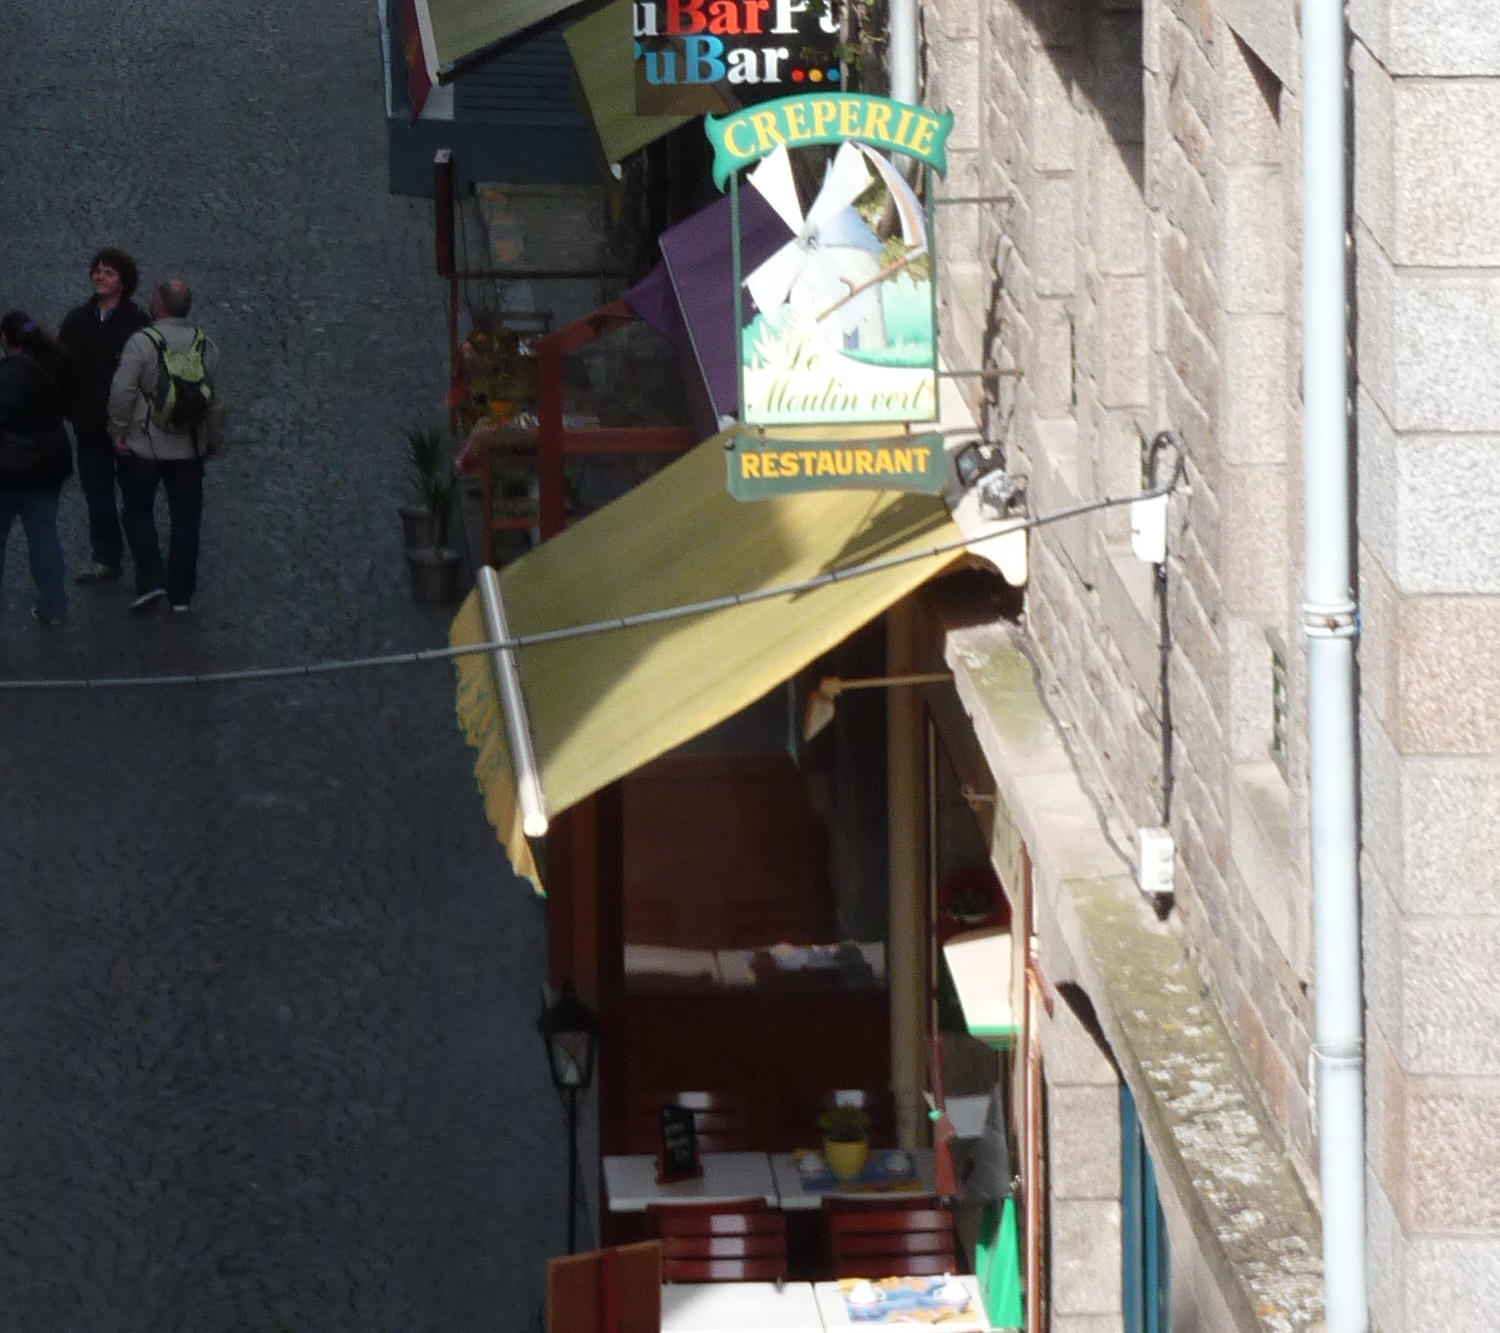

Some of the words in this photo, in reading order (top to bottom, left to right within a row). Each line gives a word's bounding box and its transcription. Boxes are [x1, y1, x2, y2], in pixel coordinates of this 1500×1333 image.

[723, 98, 940, 159] CREPERIE
[786, 336, 821, 370] Le
[747, 377, 859, 414] Moulin
[871, 377, 927, 411] vert
[741, 446, 931, 479] RESTAURANT
